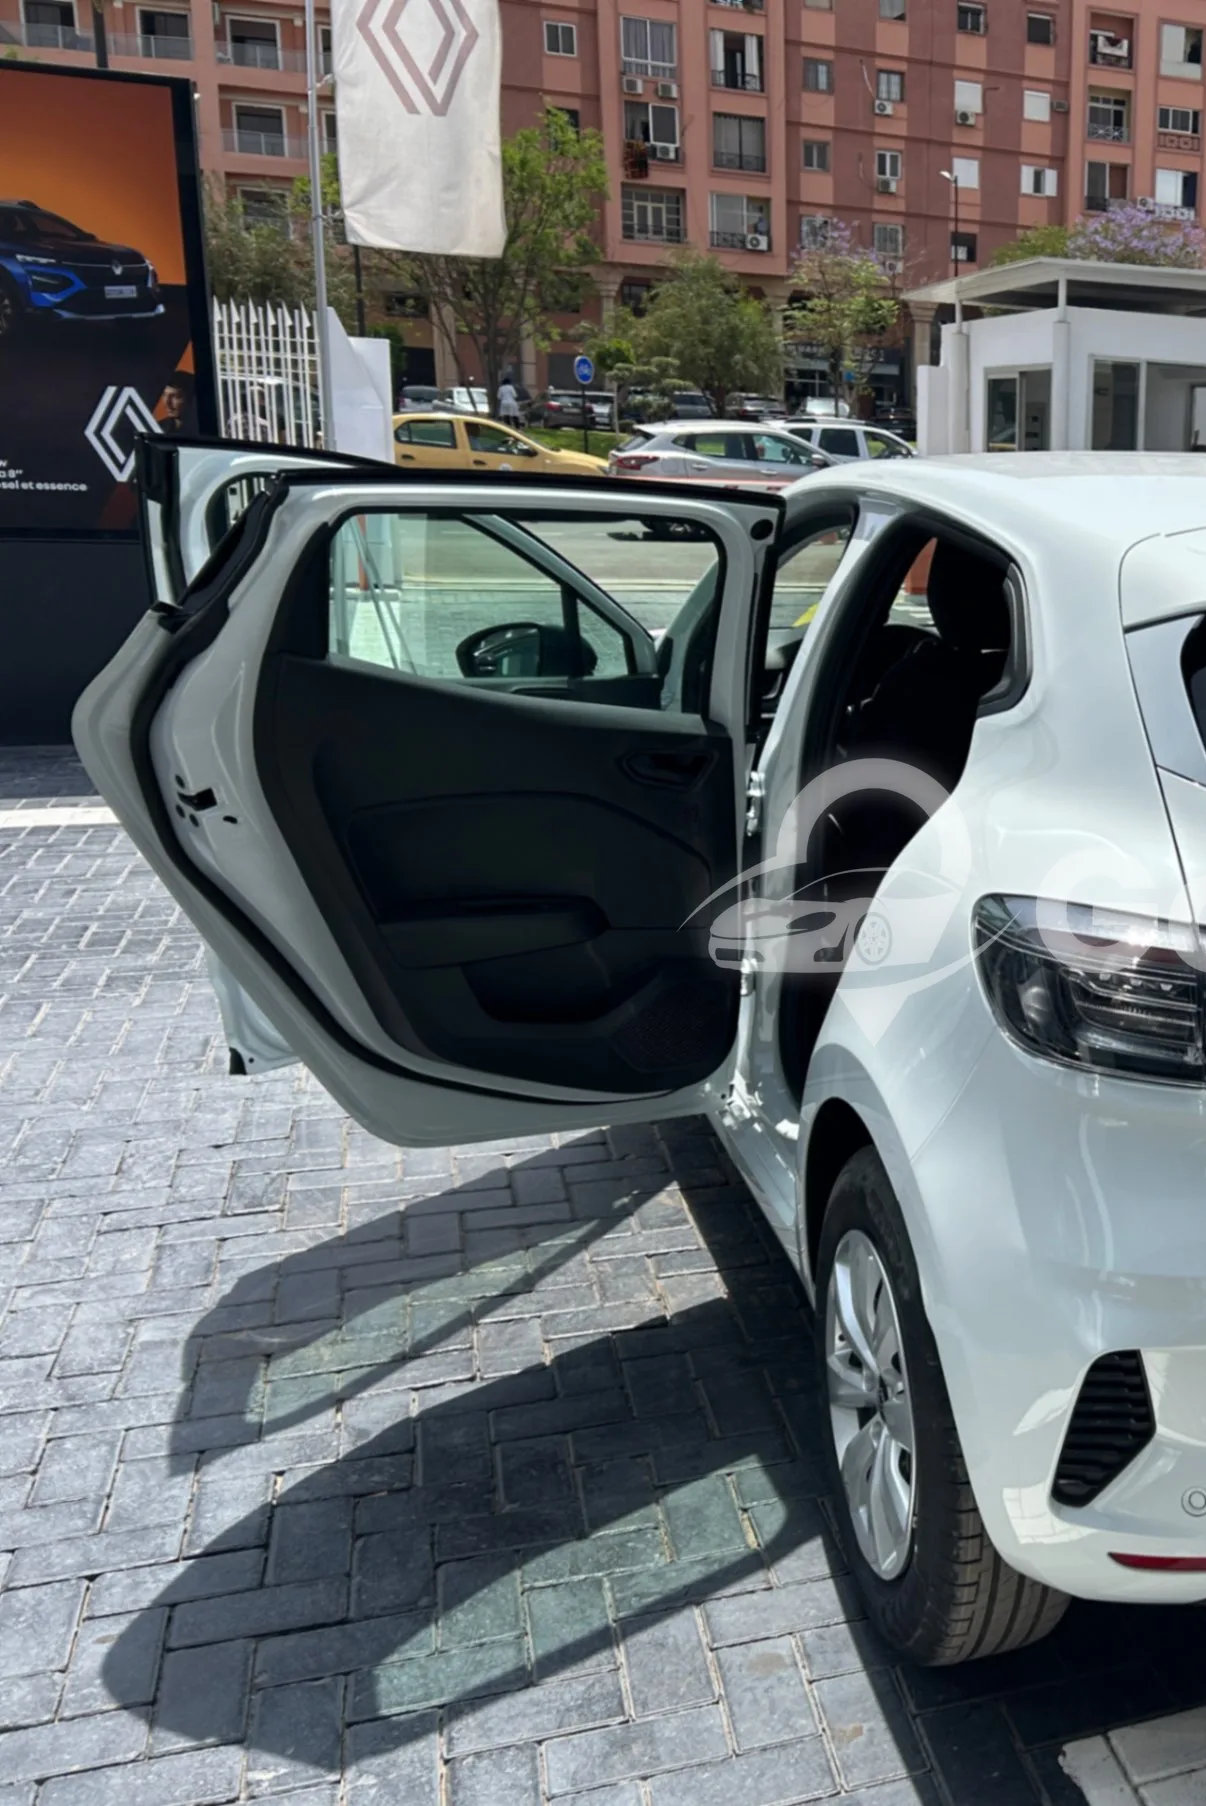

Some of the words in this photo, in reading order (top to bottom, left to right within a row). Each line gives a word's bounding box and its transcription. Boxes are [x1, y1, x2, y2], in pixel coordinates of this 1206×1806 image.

[0, 480, 19, 490] sel
[21, 482, 35, 490] et
[36, 482, 87, 491] essence
